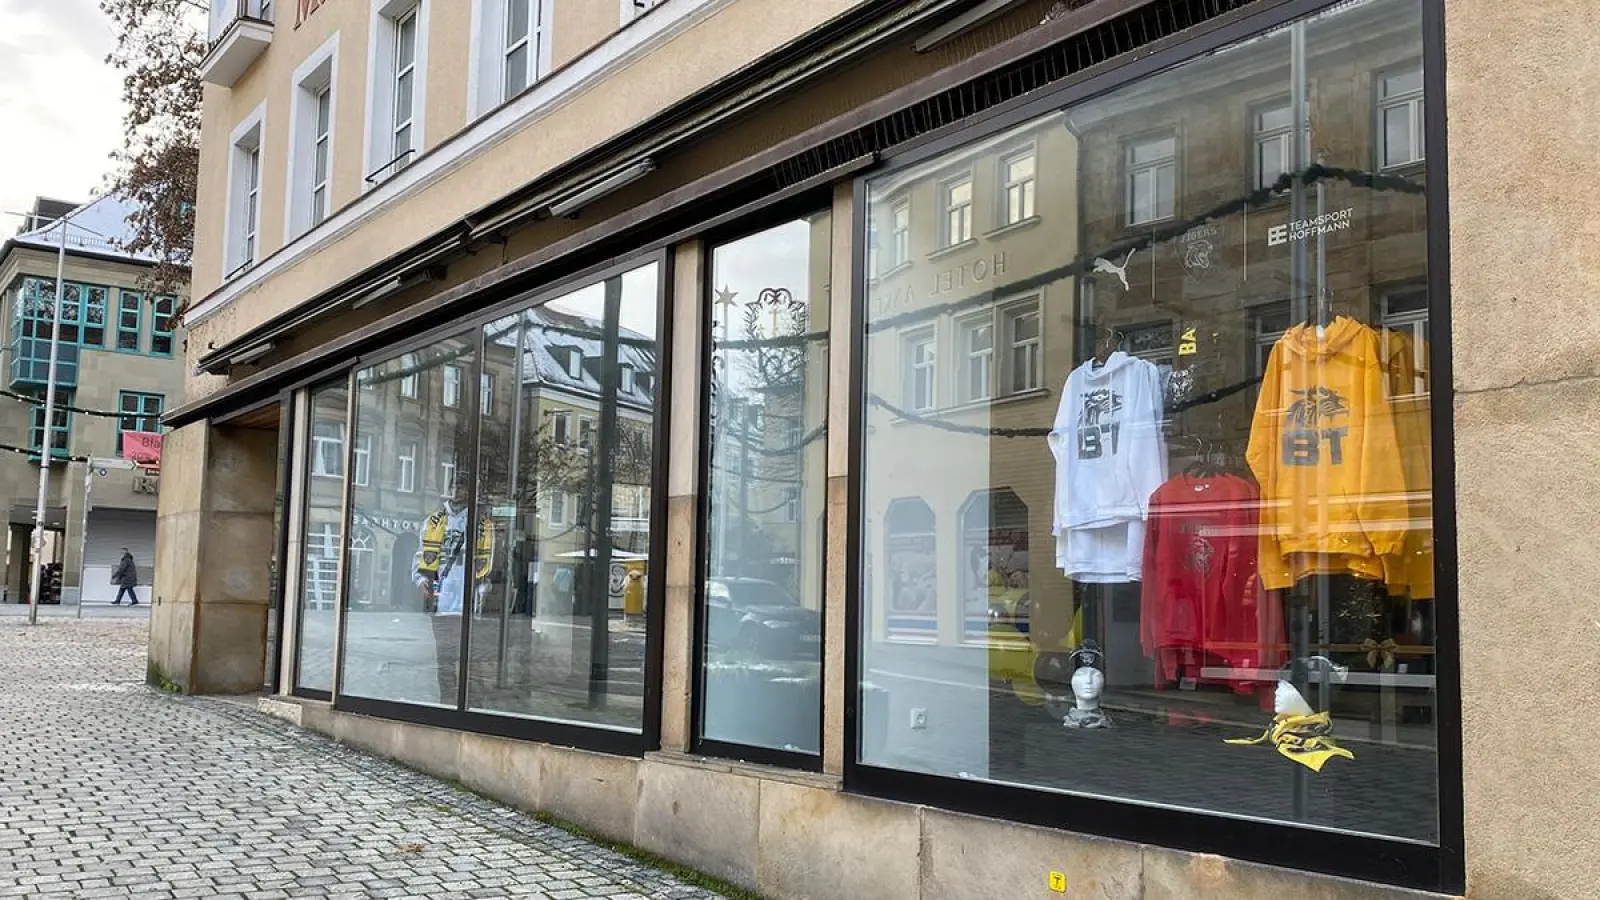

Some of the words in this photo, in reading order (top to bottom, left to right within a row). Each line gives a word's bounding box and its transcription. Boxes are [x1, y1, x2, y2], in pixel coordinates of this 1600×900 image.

[1289, 208, 1353, 232] TEAMSPORT
[1289, 219, 1350, 241] HOFFMANN
[1178, 326, 1197, 356] BA
[1077, 421, 1120, 460] BT
[1282, 427, 1348, 466] BT
